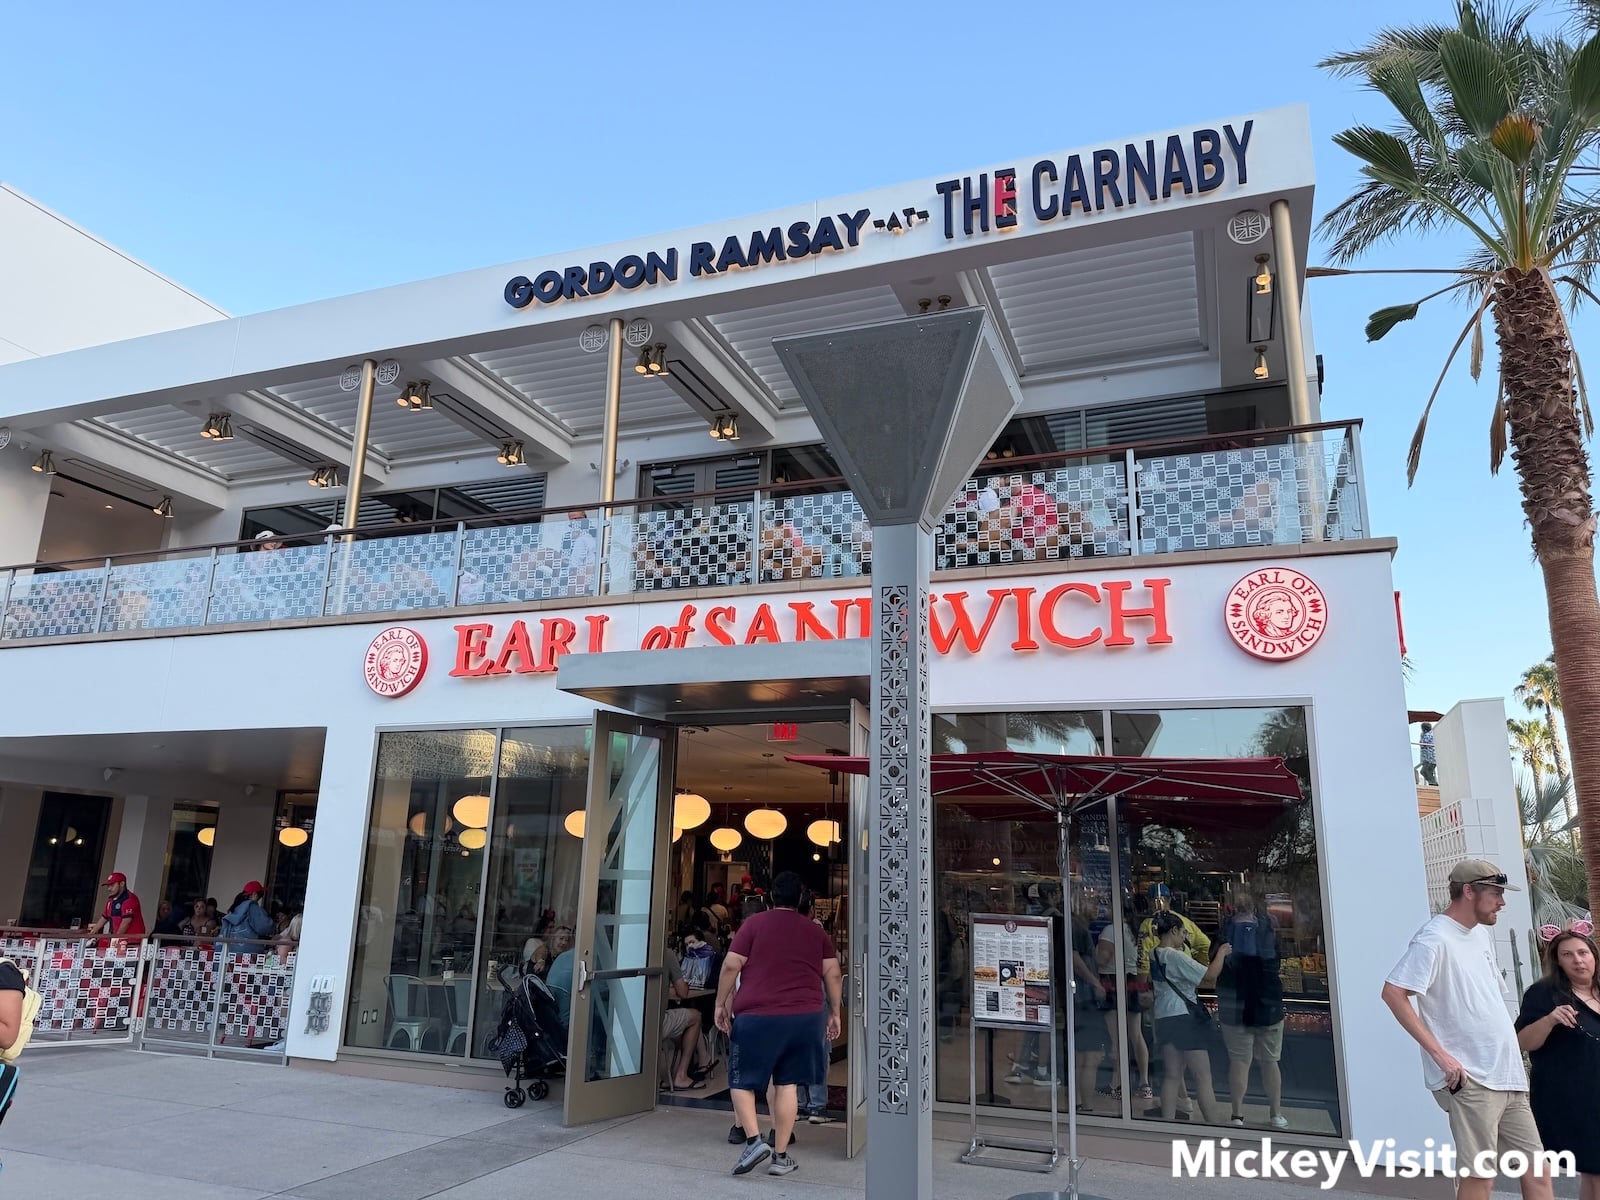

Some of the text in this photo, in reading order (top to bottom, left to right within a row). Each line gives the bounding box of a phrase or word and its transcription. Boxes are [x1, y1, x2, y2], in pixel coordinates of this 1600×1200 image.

[504, 248, 679, 309] GORDON
[689, 208, 871, 277] RAMSAY
[935, 168, 1019, 239] THE
[1032, 120, 1254, 222] CARNABY
[1234, 571, 1317, 600] EARL OF
[373, 630, 419, 651] EARL OF
[1232, 617, 1322, 654] SANDWICH
[367, 665, 418, 692] SANDWICH
